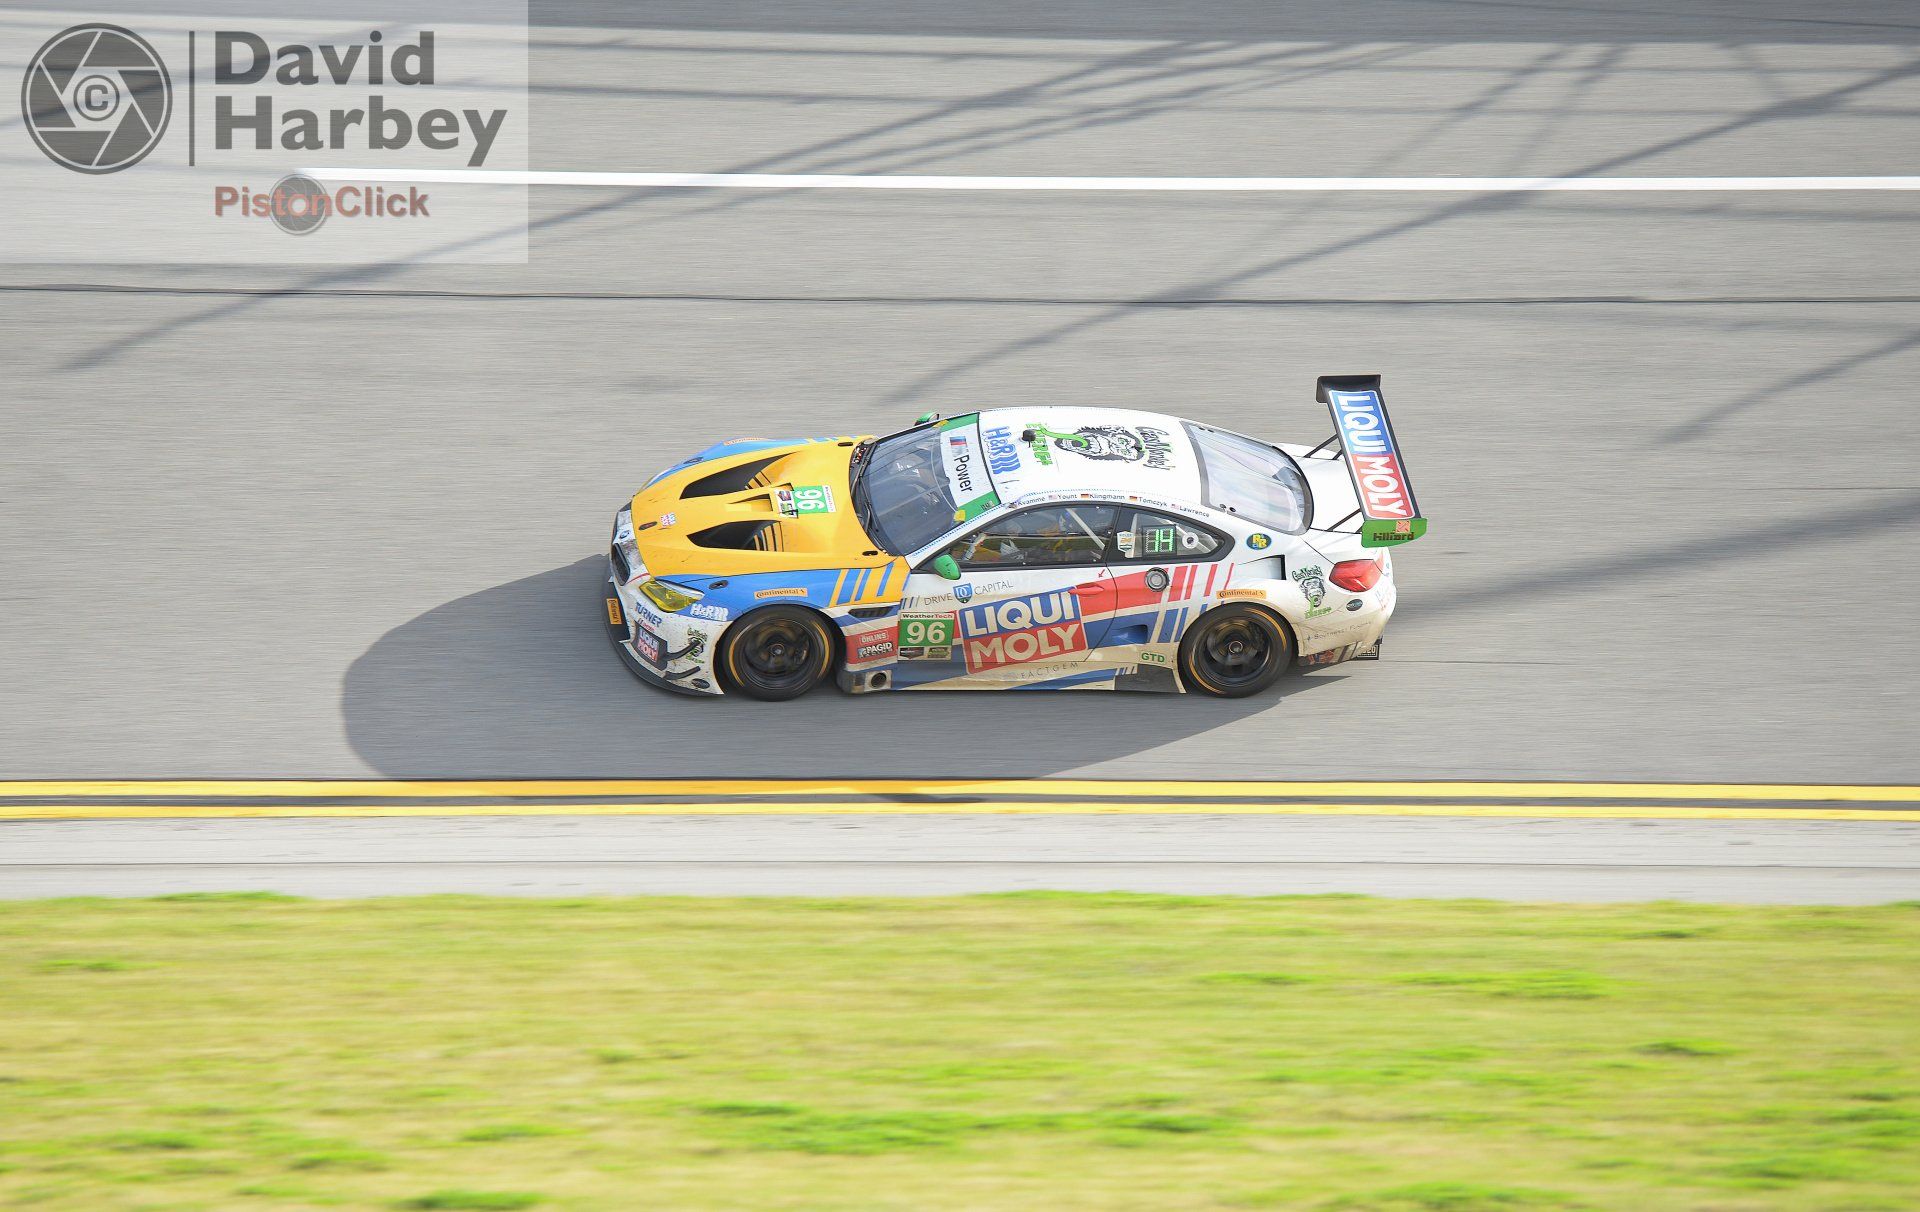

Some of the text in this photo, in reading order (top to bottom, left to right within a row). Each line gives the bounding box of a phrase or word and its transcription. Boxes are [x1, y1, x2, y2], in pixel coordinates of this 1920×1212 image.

[1337, 395, 1407, 517] LIQUI MOLY
[954, 454, 973, 492] Power
[794, 489, 825, 510] 96
[1179, 505, 1210, 518] Lawrence
[923, 592, 953, 606] DRIVE
[973, 579, 1014, 595] CAPITAL
[635, 602, 663, 628] TURNER
[964, 591, 1076, 637] LIQUI
[906, 621, 947, 644] 96
[969, 623, 1080, 669] MOLY
[1141, 652, 1165, 663] GTD
[1020, 661, 1079, 678] FACTGEM
